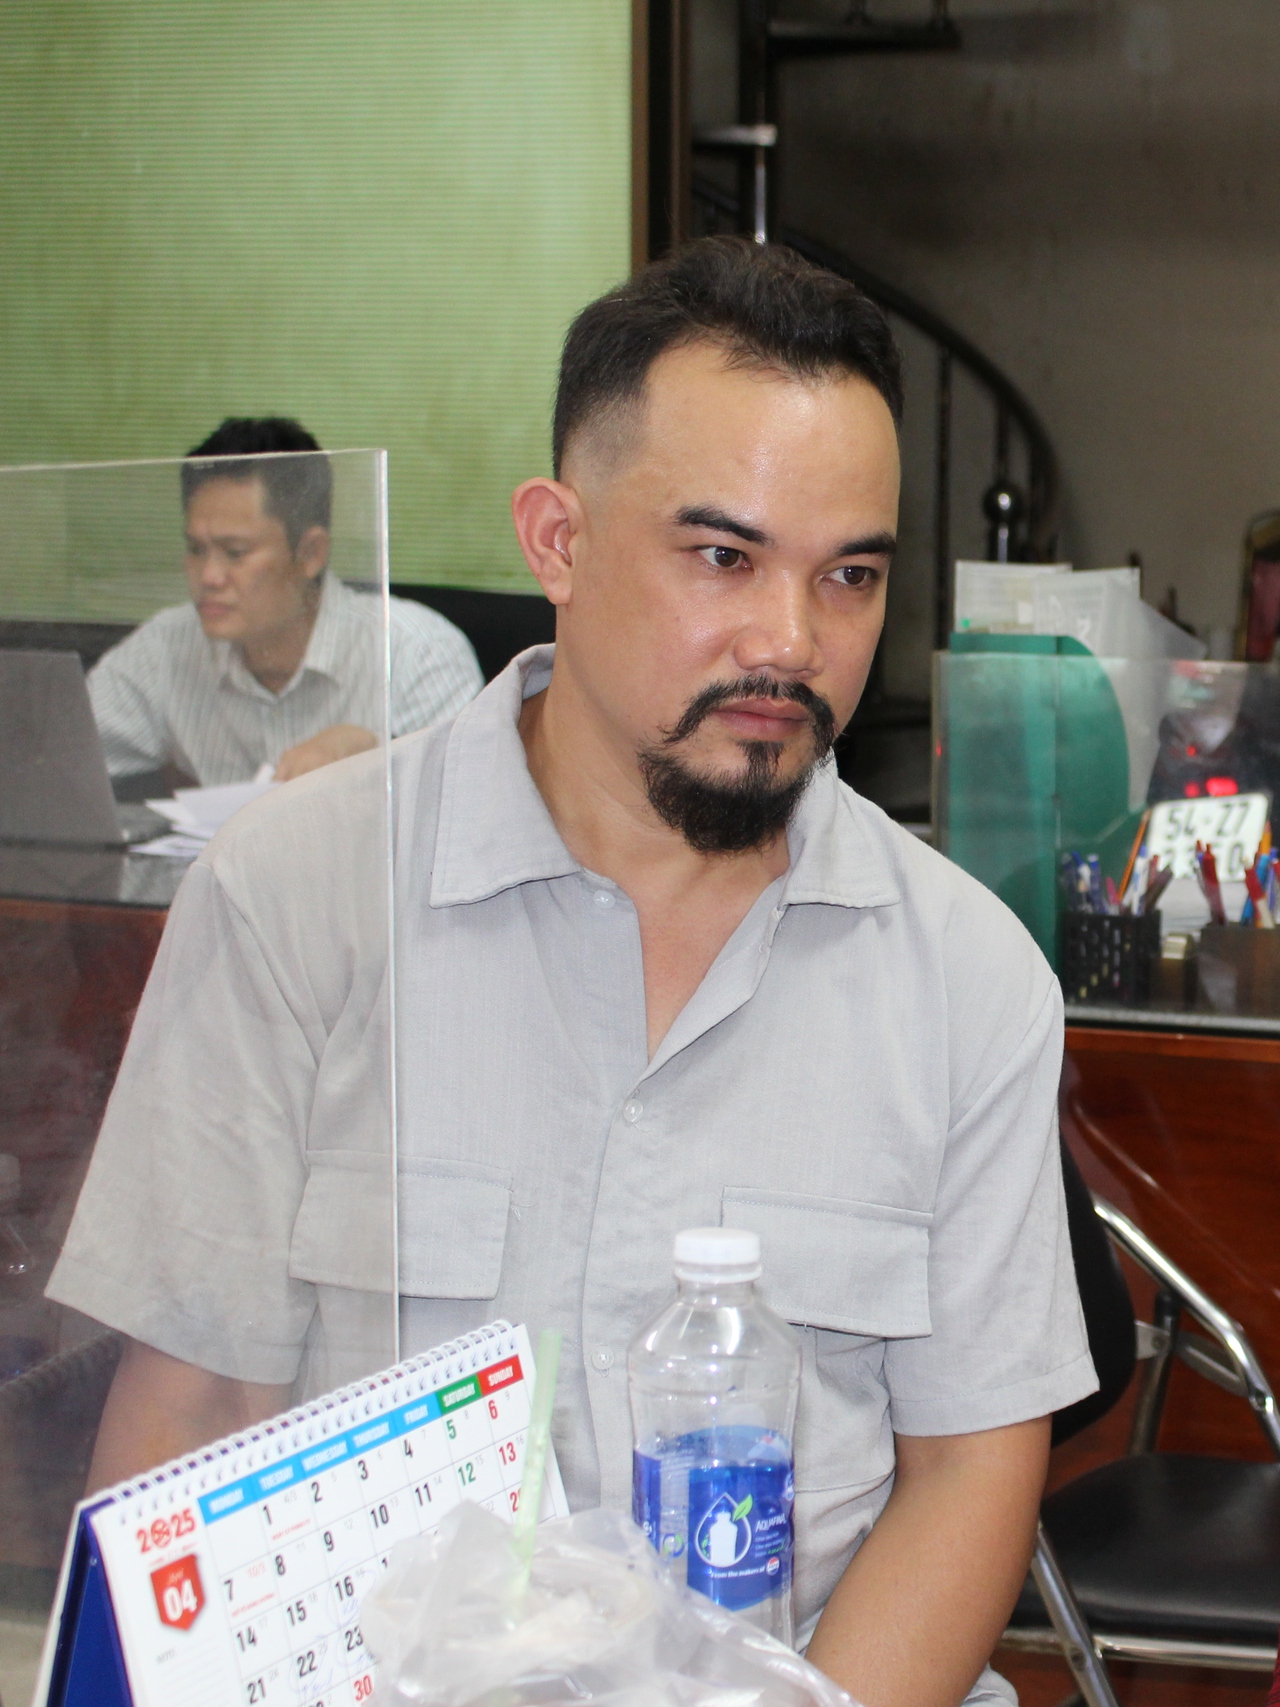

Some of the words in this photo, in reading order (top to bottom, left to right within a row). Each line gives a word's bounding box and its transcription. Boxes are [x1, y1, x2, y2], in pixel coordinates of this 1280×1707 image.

[258, 1464, 294, 1491] TUESDAY
[301, 1440, 348, 1472] WEDNESDAY
[353, 1421, 390, 1448] THURSDAY
[403, 1403, 429, 1426] FRIDAY
[442, 1383, 476, 1408] SATURDAY
[487, 1365, 514, 1387] SUNDAY
[263, 1504, 273, 1525] 1
[311, 1481, 323, 1503] 2
[357, 1460, 368, 1480] 3
[403, 1439, 413, 1459] 4
[446, 1420, 457, 1440] 5
[488, 1399, 498, 1420] 6
[224, 1578, 234, 1602] 7
[275, 1554, 286, 1576] 8
[323, 1530, 334, 1552] 9
[370, 1504, 390, 1529] 10
[415, 1482, 432, 1507] 11
[458, 1462, 476, 1486] 12
[498, 1441, 517, 1466] 13
[237, 1626, 257, 1652] 14
[286, 1600, 307, 1627] 15
[335, 1575, 354, 1601] 16
[509, 1488, 521, 1513] 2
[162, 1579, 198, 1622] 04
[247, 1677, 267, 1704] 21
[296, 1650, 318, 1678] 22
[345, 1625, 364, 1652] 23
[354, 1674, 373, 1701] 30
